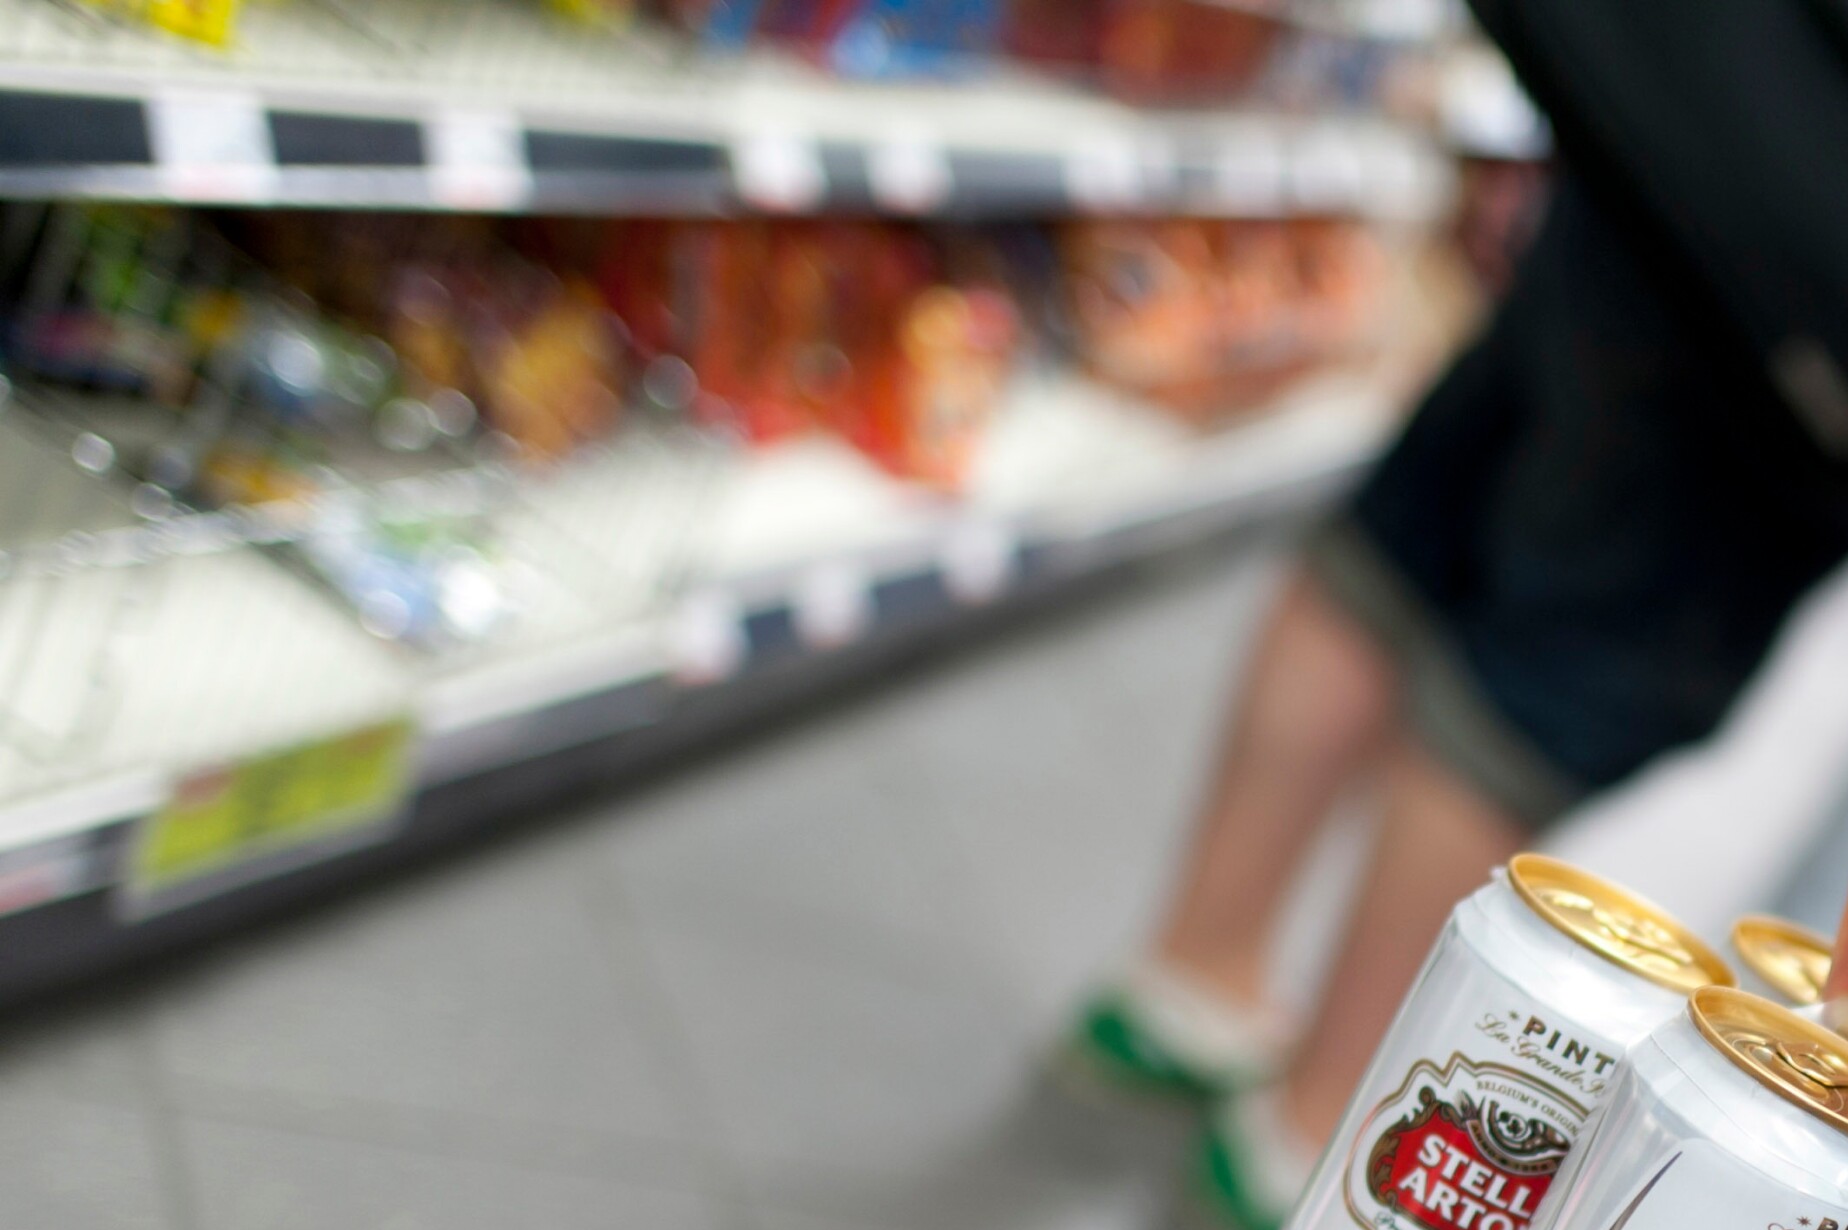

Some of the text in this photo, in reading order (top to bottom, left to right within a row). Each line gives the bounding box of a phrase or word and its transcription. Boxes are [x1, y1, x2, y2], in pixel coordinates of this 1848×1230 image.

[1475, 1013, 1510, 1043] La
[1523, 1015, 1616, 1075] PINT
[1476, 1080, 1579, 1137] BELGIUM'S ORIGIN
[1417, 1133, 1532, 1220] STELL
